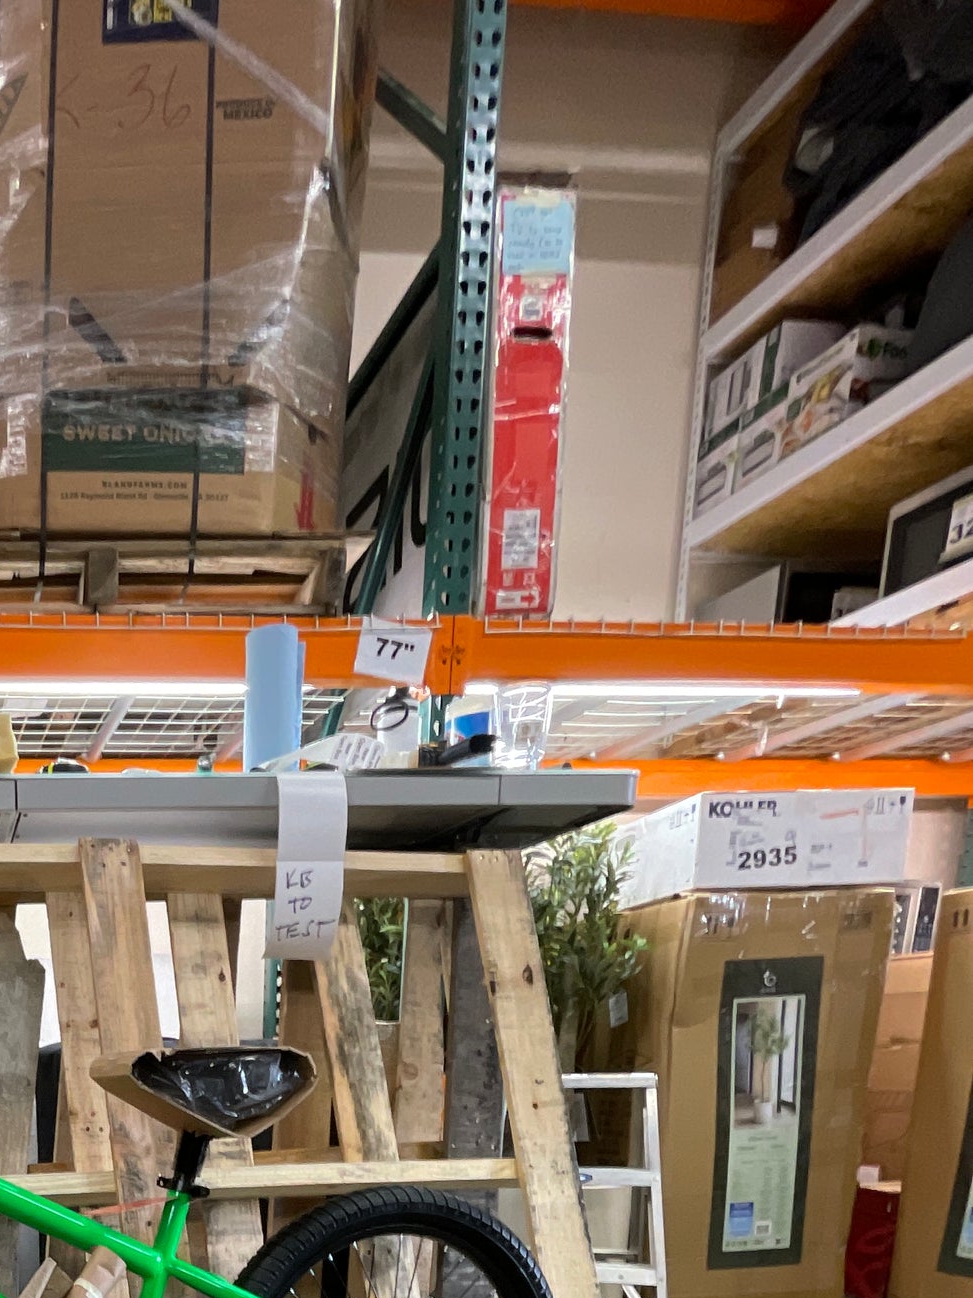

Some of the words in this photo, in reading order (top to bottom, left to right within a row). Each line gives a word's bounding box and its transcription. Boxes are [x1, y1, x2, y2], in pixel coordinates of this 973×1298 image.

[62, 423, 137, 442] SWEET
[375, 636, 416, 661] 77"
[737, 846, 798, 871] 2935
[287, 896, 313, 914] TO
[274, 919, 337, 942] TEST
